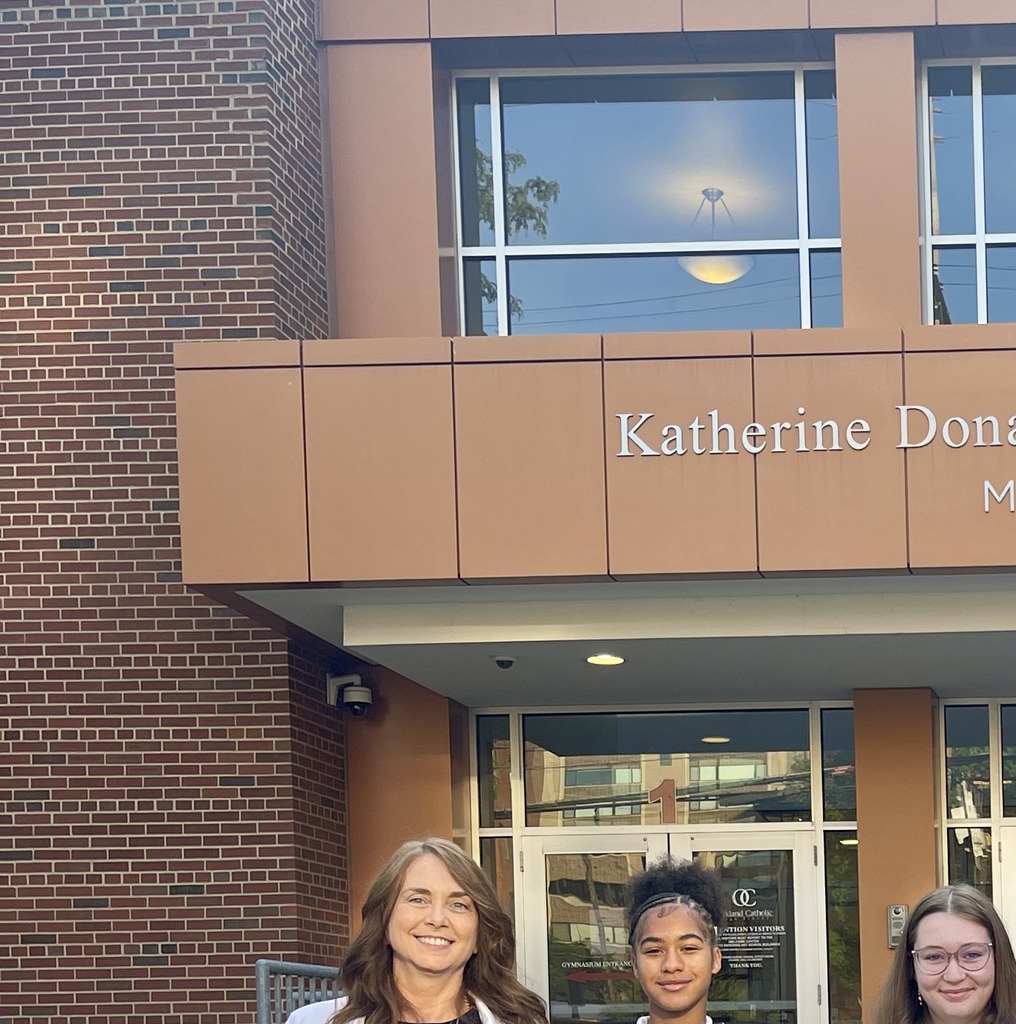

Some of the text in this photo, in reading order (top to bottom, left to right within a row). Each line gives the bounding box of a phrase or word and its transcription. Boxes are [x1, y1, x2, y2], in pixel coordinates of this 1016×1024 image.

[615, 407, 871, 457] Katherine
[648, 779, 677, 824] 1
[745, 909, 774, 918] Catholic
[749, 925, 785, 933] VISITORS
